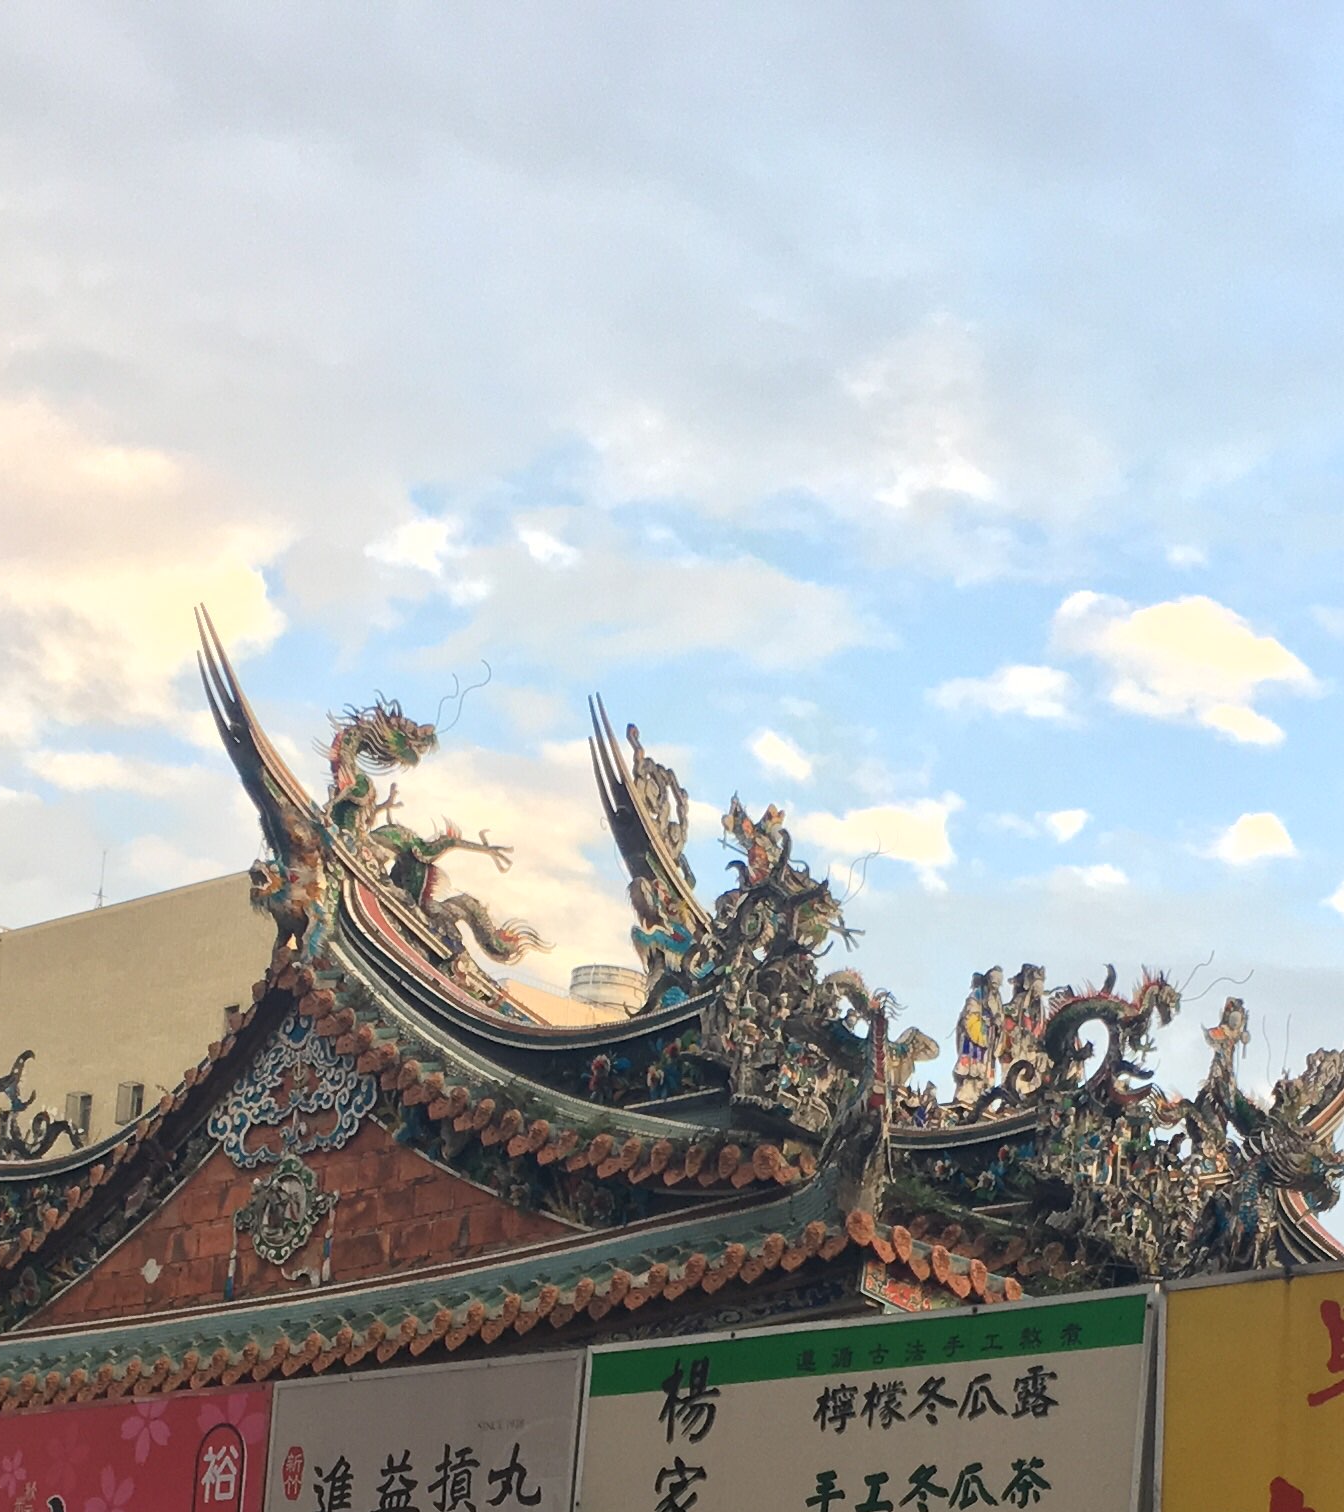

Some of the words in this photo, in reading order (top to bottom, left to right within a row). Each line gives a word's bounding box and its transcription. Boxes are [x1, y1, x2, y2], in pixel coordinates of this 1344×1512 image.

[813, 1364, 1060, 1434] 檸檬冬瓜露
